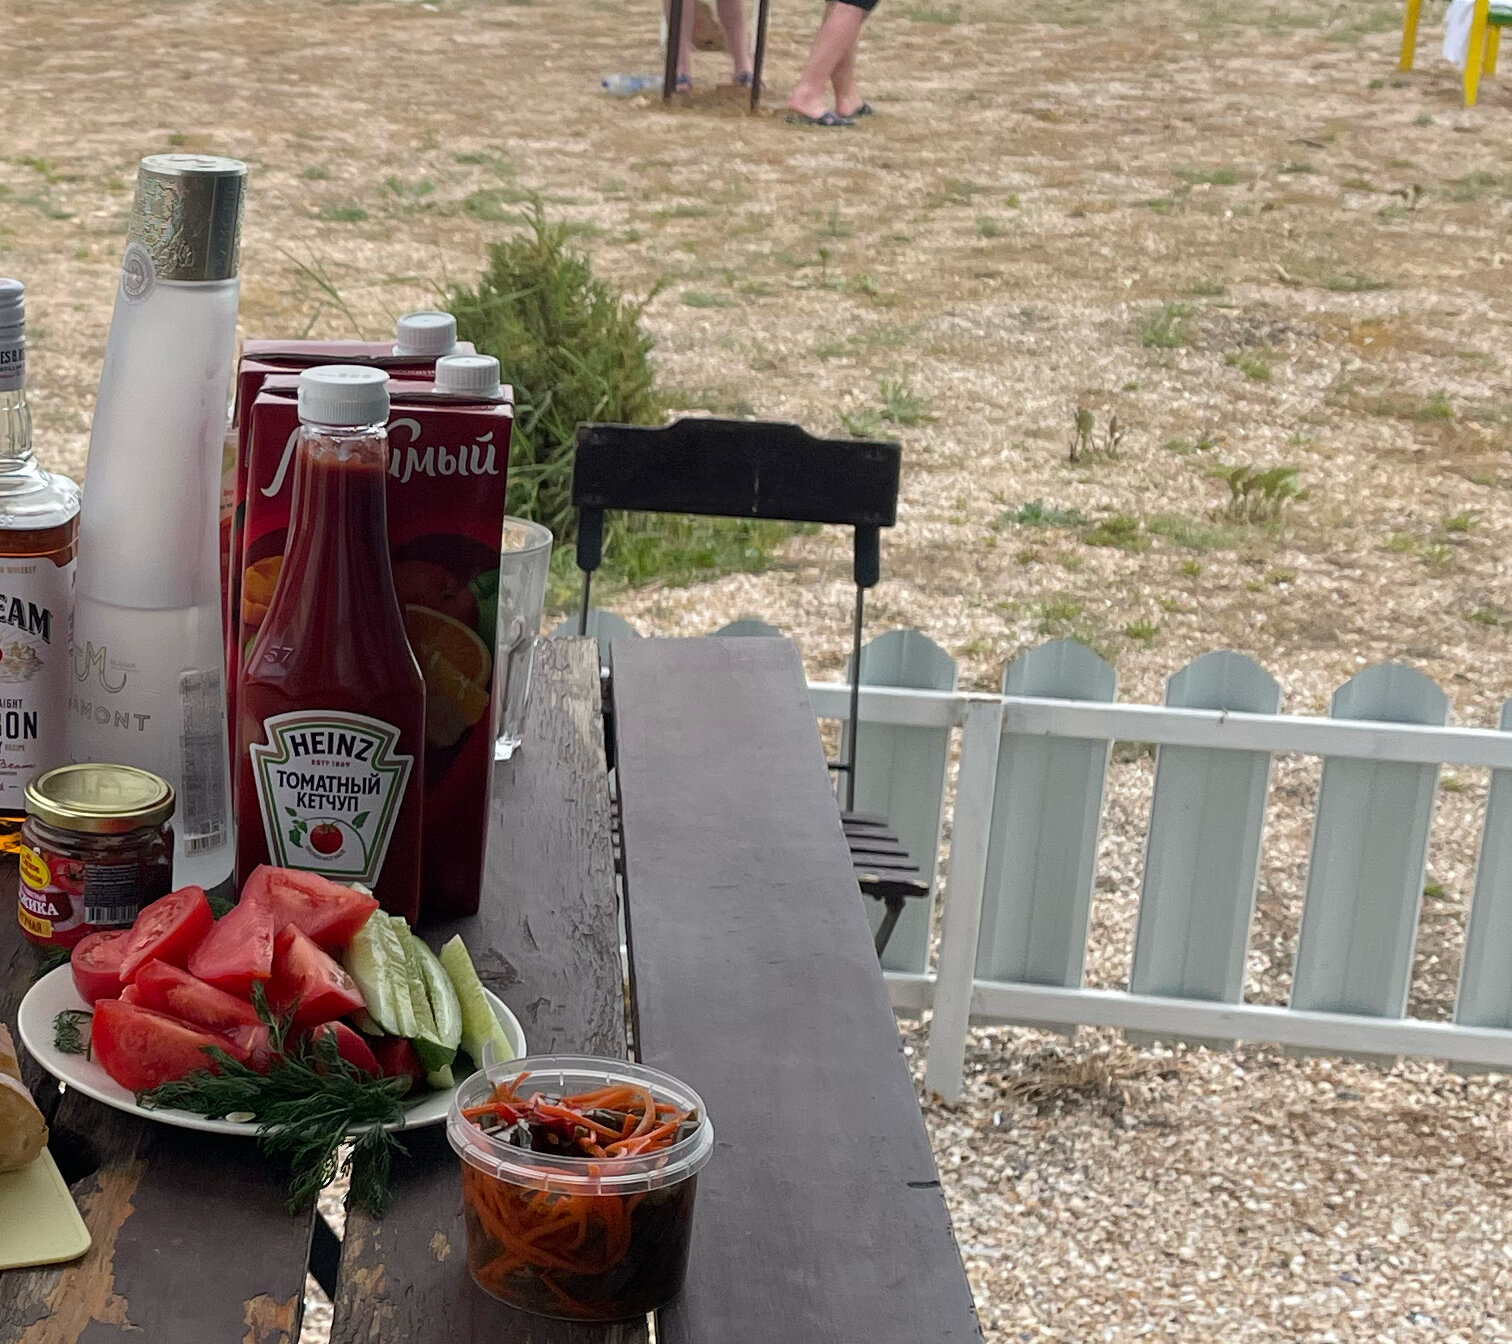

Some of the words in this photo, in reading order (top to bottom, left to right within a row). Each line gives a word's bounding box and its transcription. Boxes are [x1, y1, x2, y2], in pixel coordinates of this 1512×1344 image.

[288, 731, 375, 763] HEINZ
[276, 769, 381, 796] ТОМАТНЫЙ
[296, 791, 360, 813] КЕТЧУП
